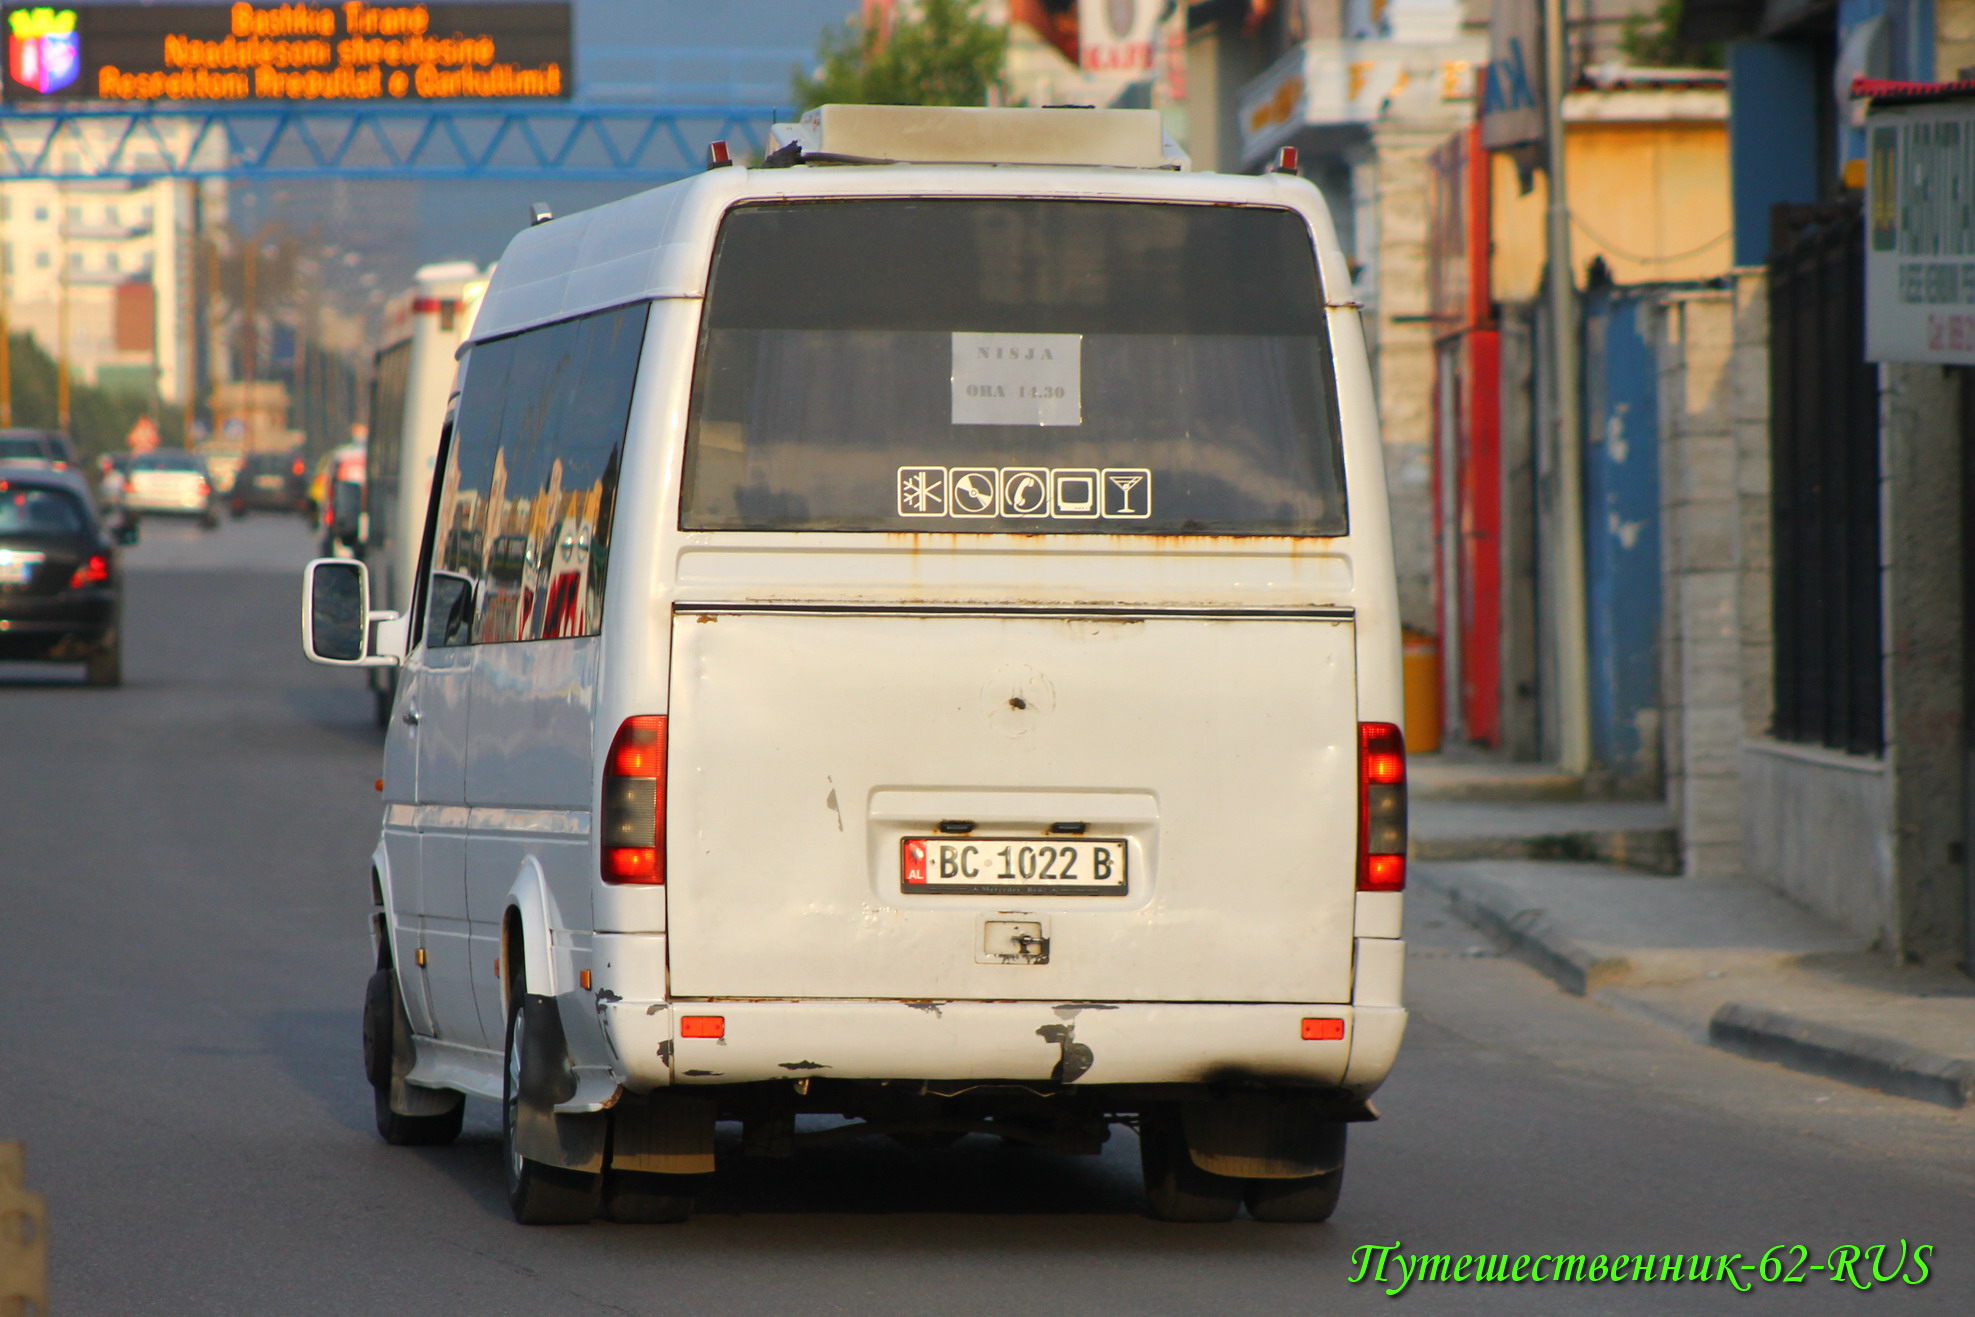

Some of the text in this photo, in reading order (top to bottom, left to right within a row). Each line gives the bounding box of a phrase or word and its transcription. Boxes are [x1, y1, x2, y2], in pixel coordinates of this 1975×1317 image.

[231, 2, 335, 37] Bashkia
[99, 65, 249, 99] Respektoni
[388, 70, 409, 98] e
[977, 346, 1053, 360] NISJA
[966, 384, 1065, 399] ORA 14.30
[907, 869, 925, 880] AL
[940, 845, 1112, 880] BC 1022 B
